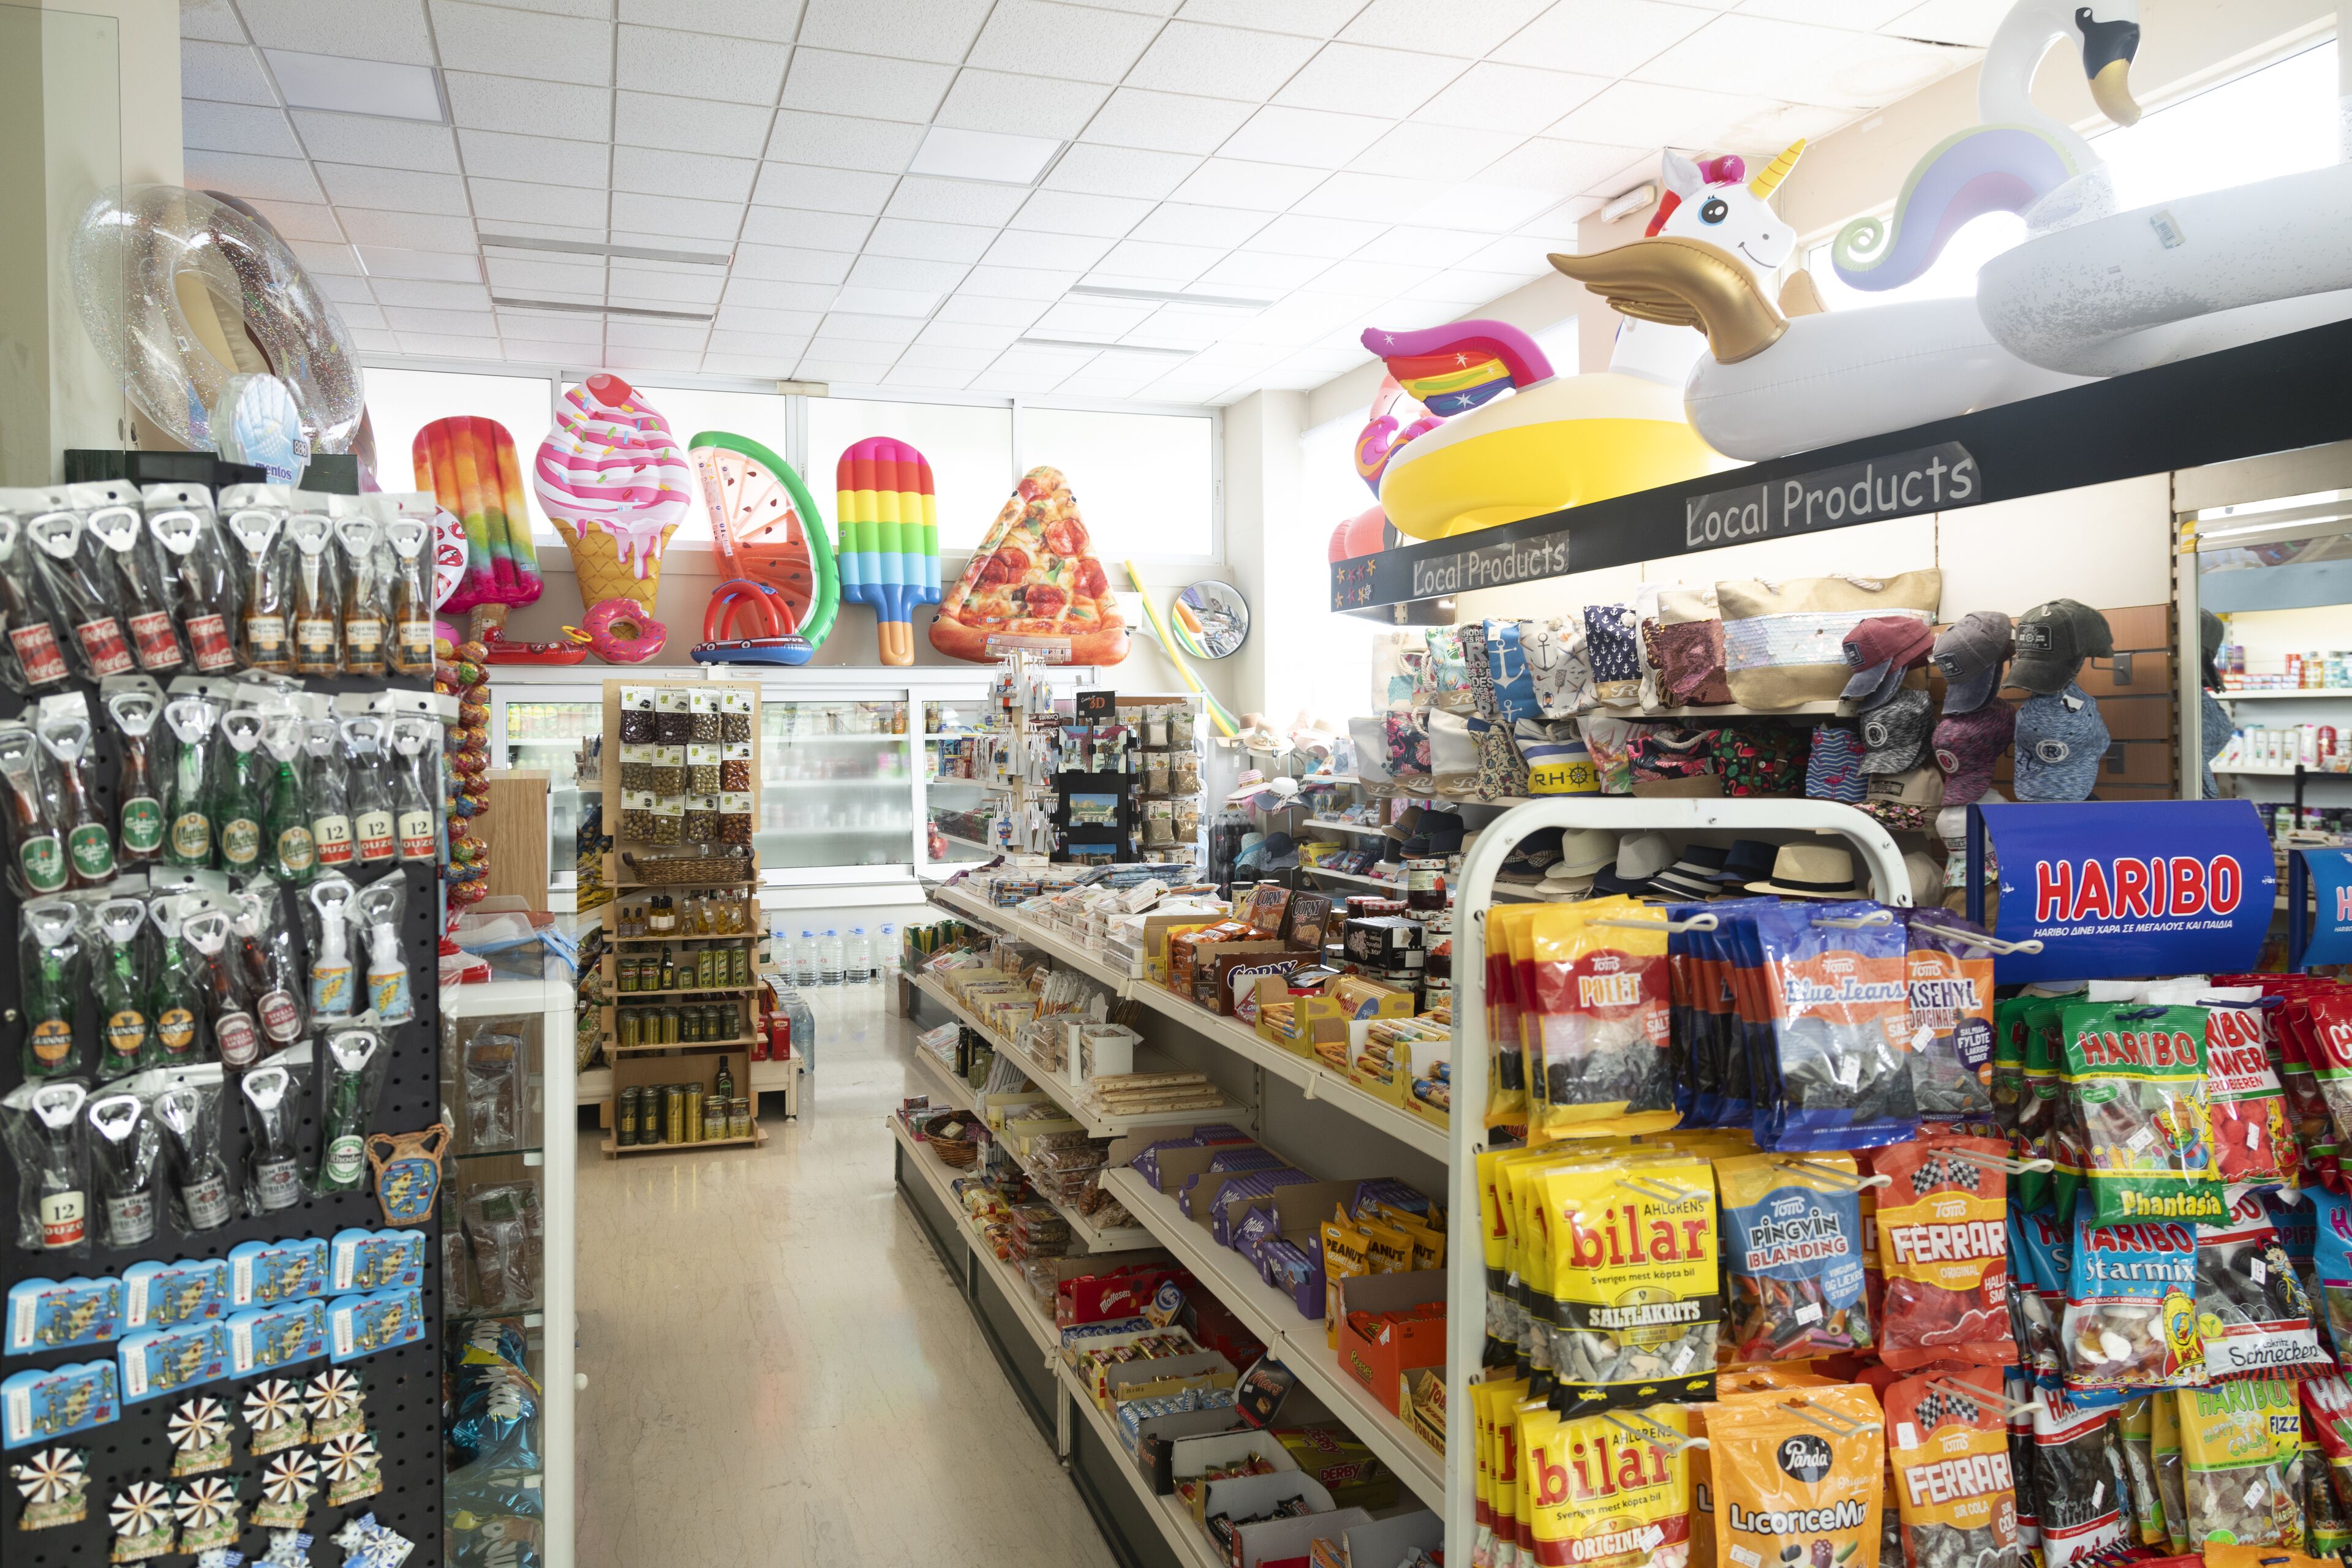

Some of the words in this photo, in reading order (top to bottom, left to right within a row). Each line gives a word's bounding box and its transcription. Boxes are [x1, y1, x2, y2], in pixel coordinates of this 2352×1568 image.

[1687, 489, 1768, 547] Local
[1784, 456, 1972, 528] Products
[1413, 554, 1461, 597] Local
[1468, 541, 1566, 590] Products
[1089, 697, 1105, 709] 3D
[325, 826, 344, 840] 12
[368, 822, 385, 837] 12
[411, 821, 427, 835] 12
[1256, 888, 1284, 906] CORNY
[2035, 854, 2242, 923] HARIBO
[1292, 898, 1324, 918] CORNY
[2034, 928, 2069, 938] HARIBO
[2071, 925, 2094, 936] ΔΙΝΕΙ
[2096, 924, 2120, 935] ΧΑΡΑ
[2122, 924, 2134, 933] ΣΕ
[2185, 921, 2201, 930] ΚΑΙ
[2203, 920, 2233, 930] ΠΑΙΔΙΑ
[1591, 957, 1621, 971] Toms
[1823, 957, 1855, 973] Toms
[1909, 960, 1942, 976] Toms
[1784, 976, 1836, 1003] Blue
[1838, 976, 1908, 1004] Jeans
[1958, 1033, 1991, 1049] FYLDTE
[2078, 1031, 2199, 1066] HARIBO
[1220, 1190, 1240, 1204] Milka
[1771, 1196, 1806, 1217] Toms
[2120, 1188, 2222, 1216] Phantasia
[53, 1204, 74, 1220] 12
[1644, 1201, 1705, 1216] AHLGRENS
[1931, 1199, 1966, 1218] Toms
[1243, 1217, 1264, 1233] Milka
[1564, 1204, 1711, 1270] bilar
[1890, 1219, 2007, 1264] FERRAR
[2081, 1223, 2196, 1254] HARIBO
[1327, 1237, 1365, 1264] PEANUT
[1746, 1236, 1849, 1271] BLANDING
[1591, 1273, 1626, 1284] Sveriges
[1629, 1271, 1651, 1281] mest
[1654, 1269, 1681, 1282] köpta
[1684, 1268, 1695, 1277] bil
[1940, 1265, 1980, 1279] ORIGINAL
[2086, 1257, 2196, 1282] Starmix
[1825, 1281, 1837, 1292] OG
[1099, 1289, 1131, 1314] Maltesers
[1589, 1300, 1701, 1328] SALTLAKRITS
[2228, 1341, 2320, 1366] Schnecken
[1248, 1370, 1283, 1396] Mars
[2196, 1379, 2290, 1417] HARIBO
[1305, 1428, 1345, 1455] DERBY
[1939, 1433, 1969, 1453] Toms
[2228, 1427, 2267, 1457] COLA
[1785, 1441, 1828, 1471] Panda
[1320, 1462, 1363, 1483] DERBY
[1532, 1435, 1678, 1509] bilar
[1556, 1508, 1596, 1521] Sveriges
[1599, 1502, 1621, 1513] mest
[1623, 1496, 1648, 1510] köpta
[1649, 1493, 1661, 1502] bil
[1968, 1499, 1990, 1516] COLA
[2001, 1501, 2013, 1515] SUR
